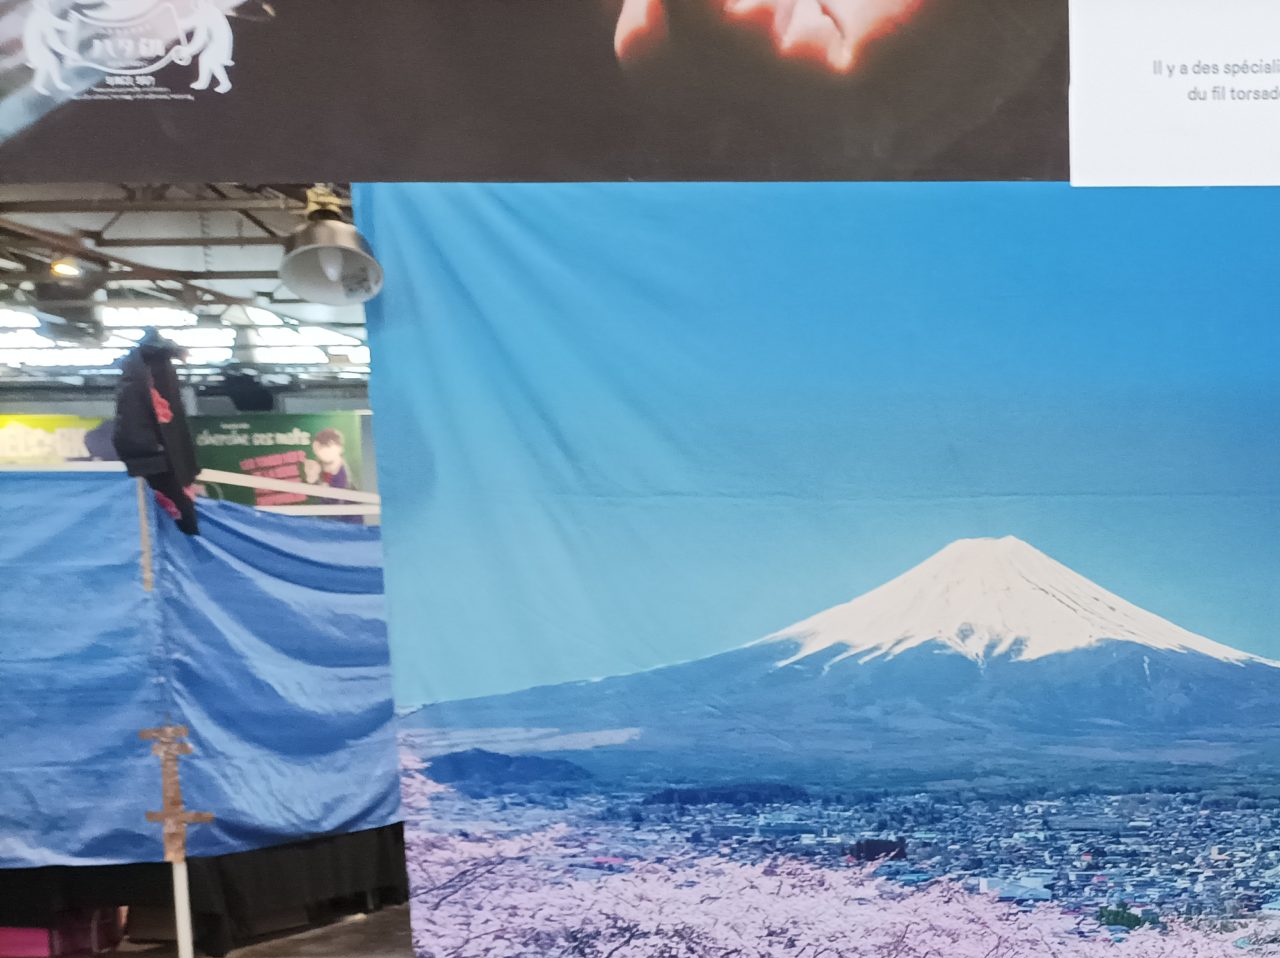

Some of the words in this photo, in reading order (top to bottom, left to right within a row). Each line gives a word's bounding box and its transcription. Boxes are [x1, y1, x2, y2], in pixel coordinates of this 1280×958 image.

[1153, 60, 1163, 75] Il
[1166, 63, 1176, 78] y
[1179, 63, 1189, 76] a
[1191, 59, 1220, 75] des
[1187, 86, 1208, 102] du
[1211, 85, 1226, 101] fil
